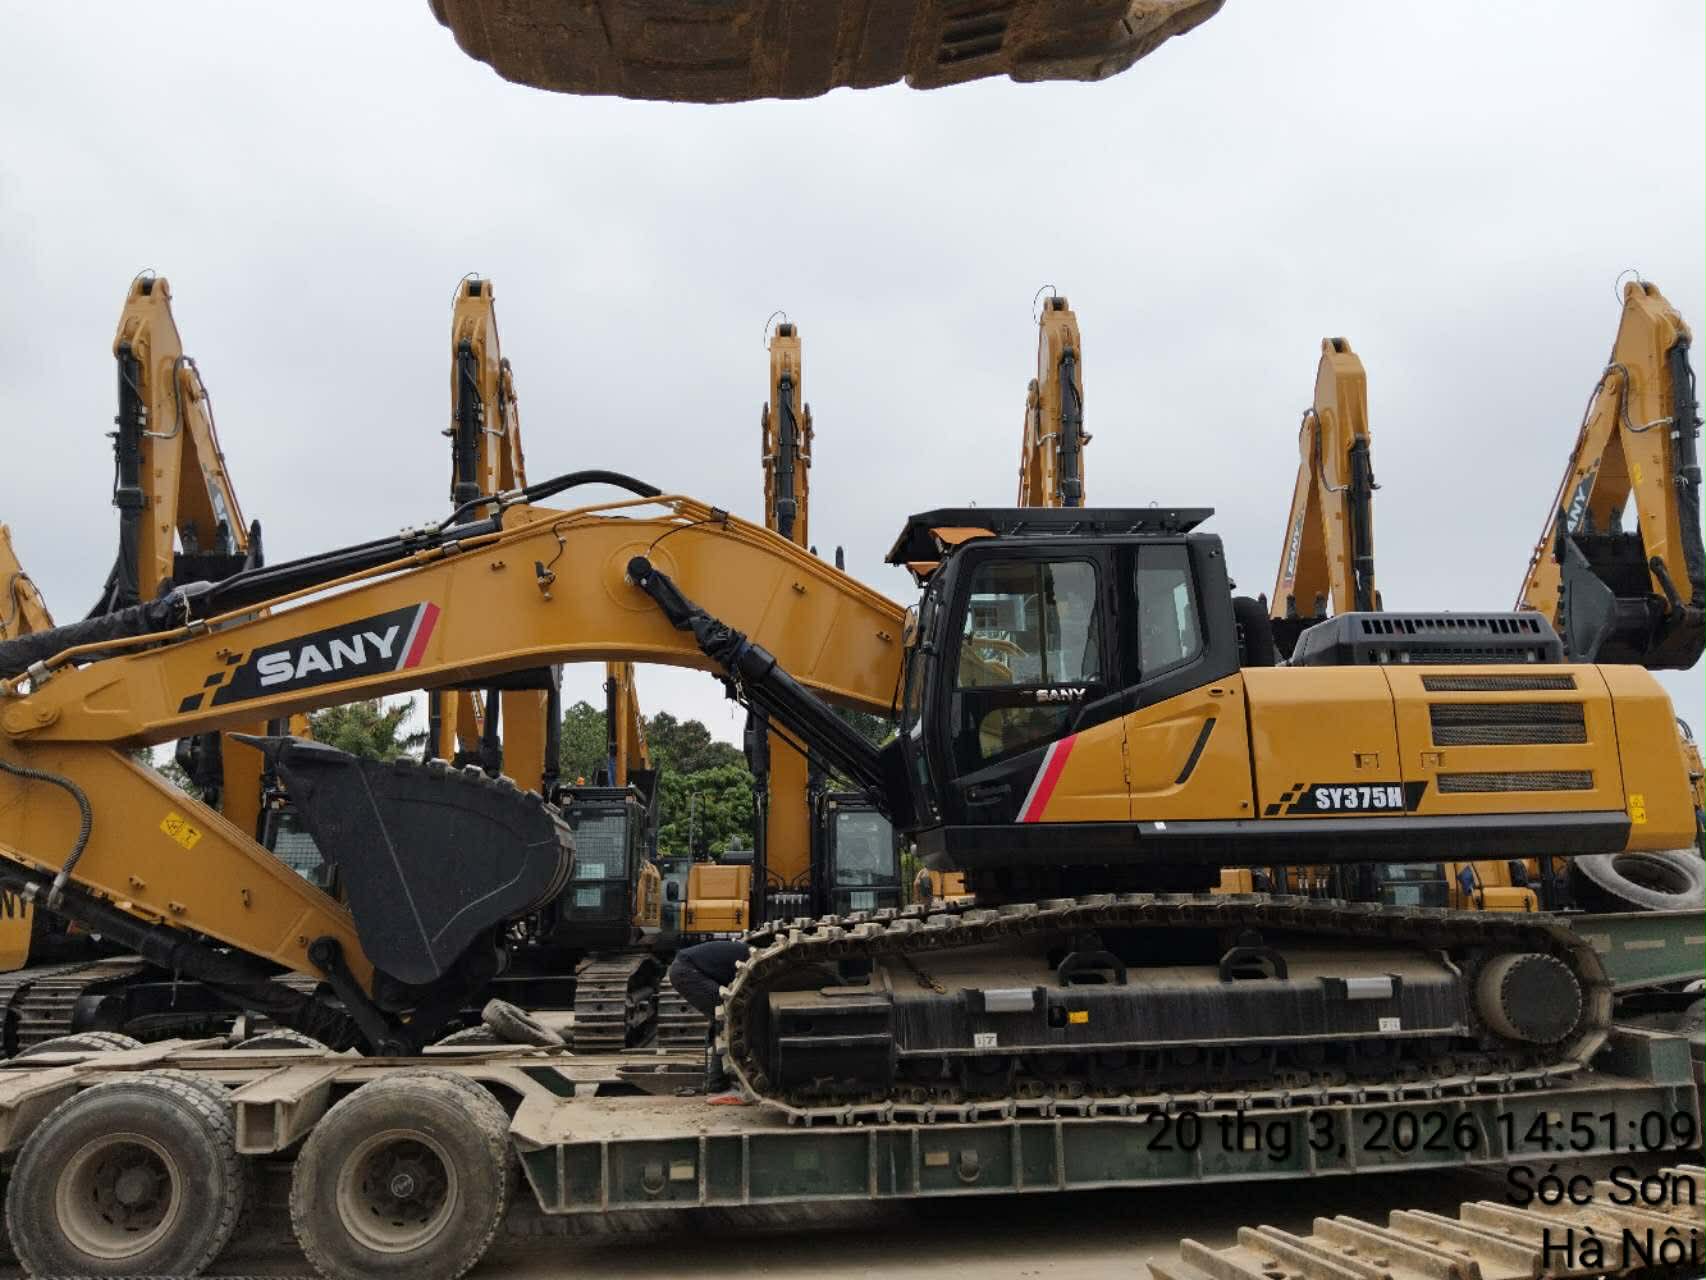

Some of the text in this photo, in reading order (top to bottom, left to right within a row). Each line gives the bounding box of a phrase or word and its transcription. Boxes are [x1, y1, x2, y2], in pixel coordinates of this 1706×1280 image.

[256, 625, 401, 687] SANY
[1036, 687, 1087, 701] SANY
[1315, 786, 1403, 810] SY375H
